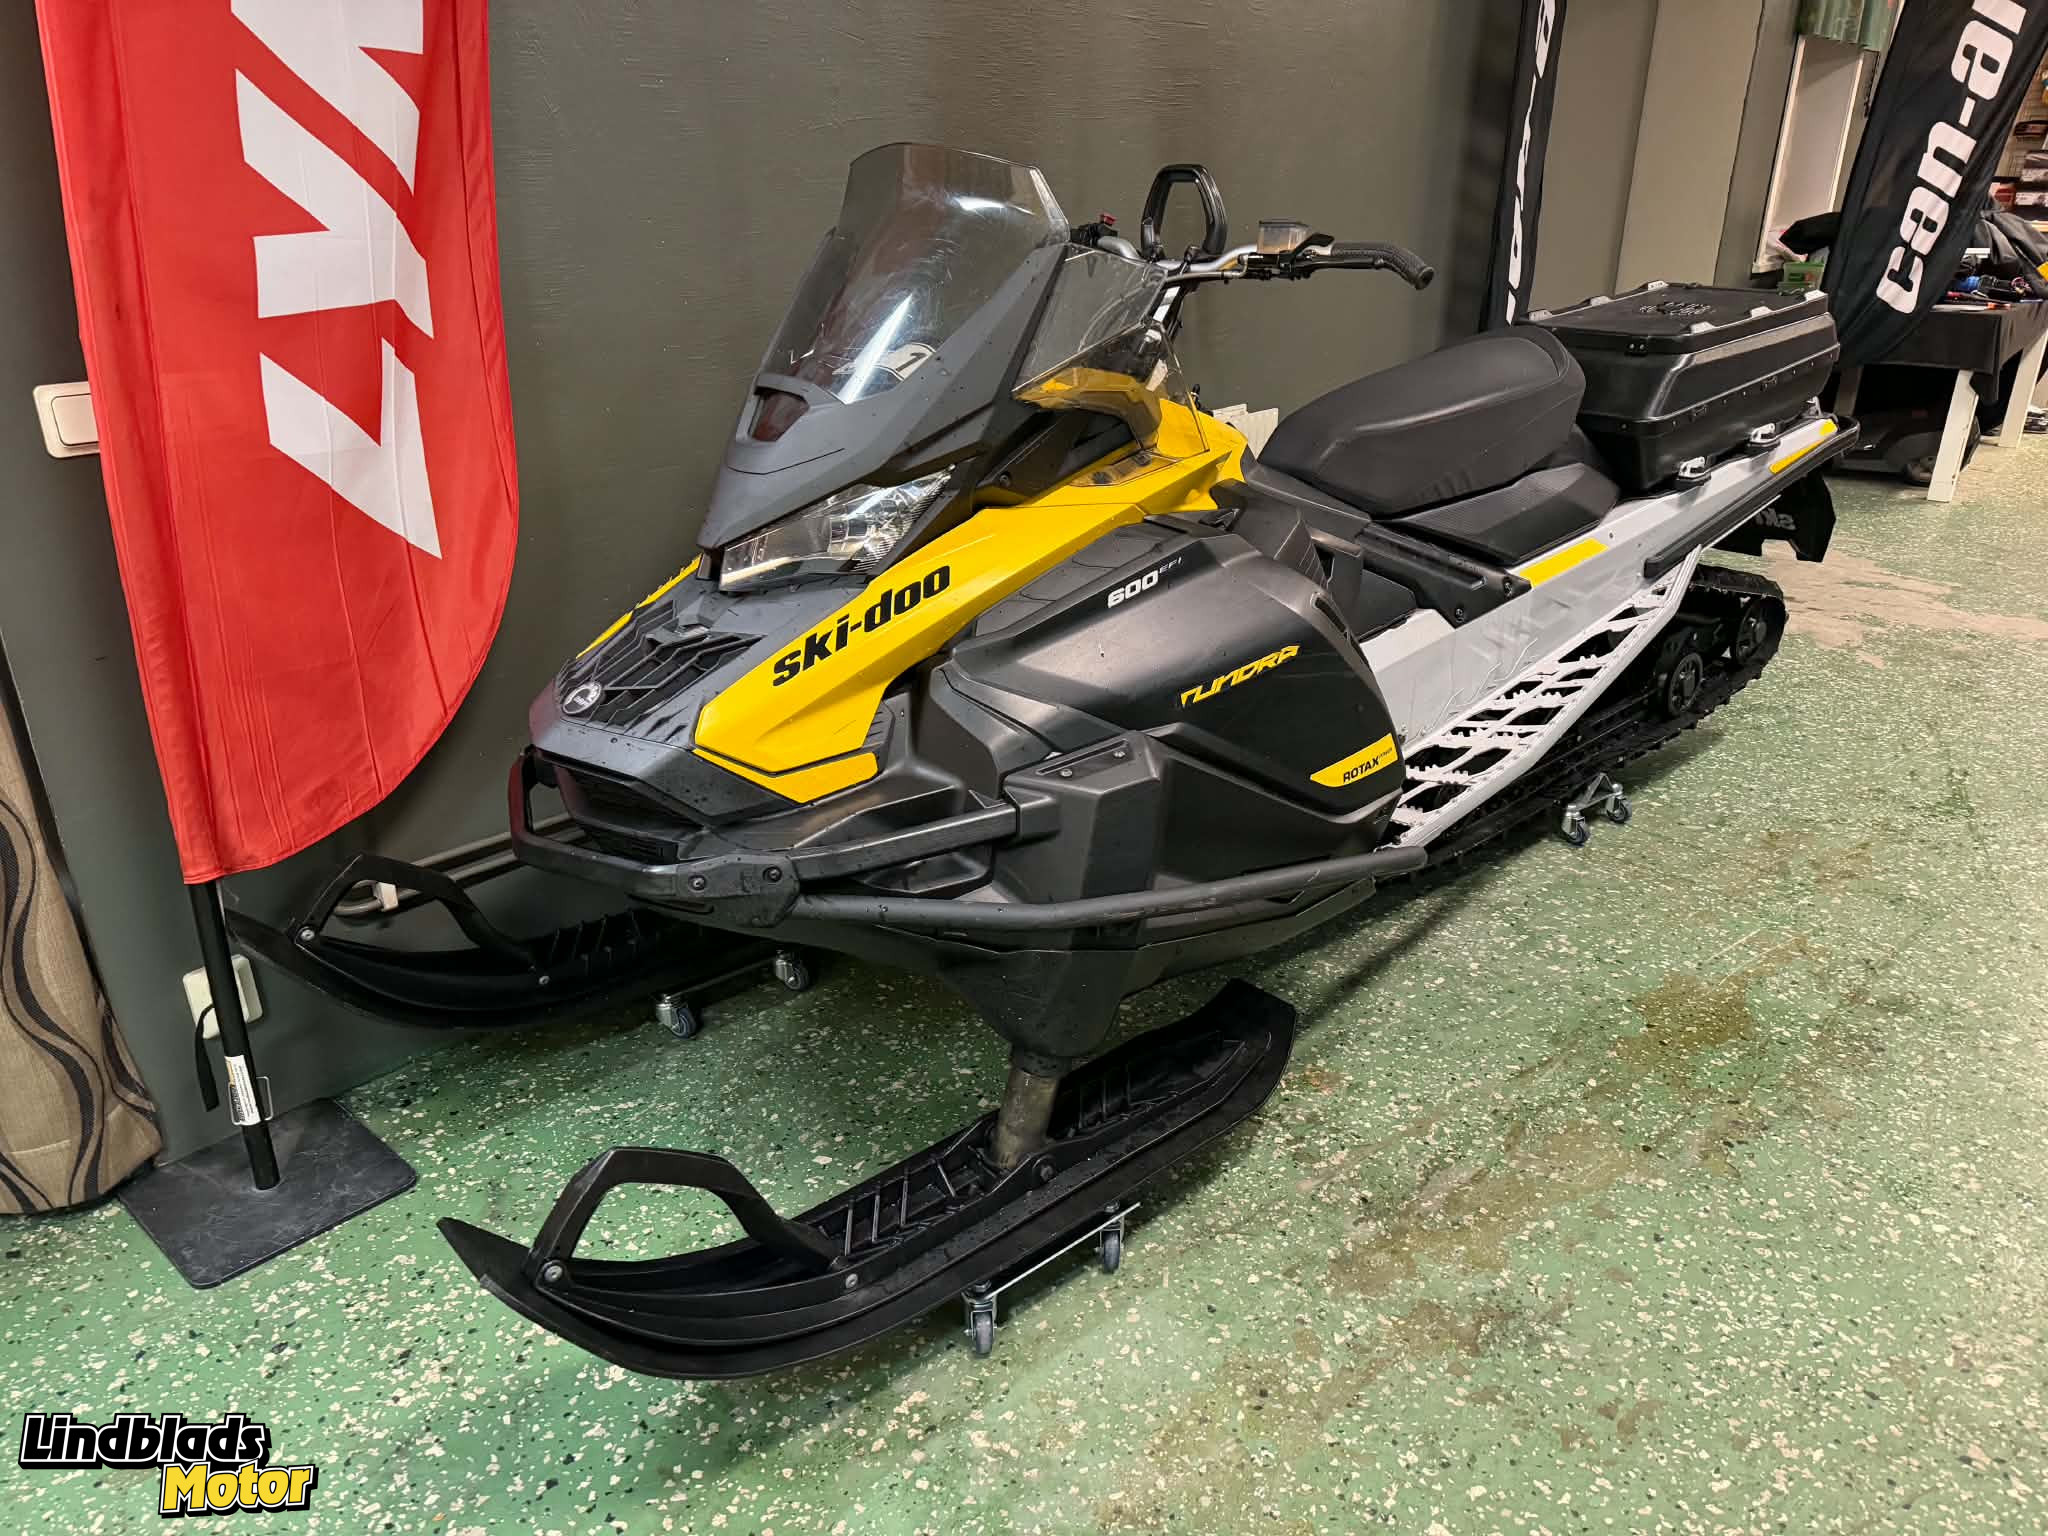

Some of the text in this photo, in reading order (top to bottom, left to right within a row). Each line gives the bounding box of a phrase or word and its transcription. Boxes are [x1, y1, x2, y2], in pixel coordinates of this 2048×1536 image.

[1107, 570, 1159, 609] 600
[1180, 645, 1301, 708] TUNDRA
[1343, 756, 1379, 783] ROTAX
